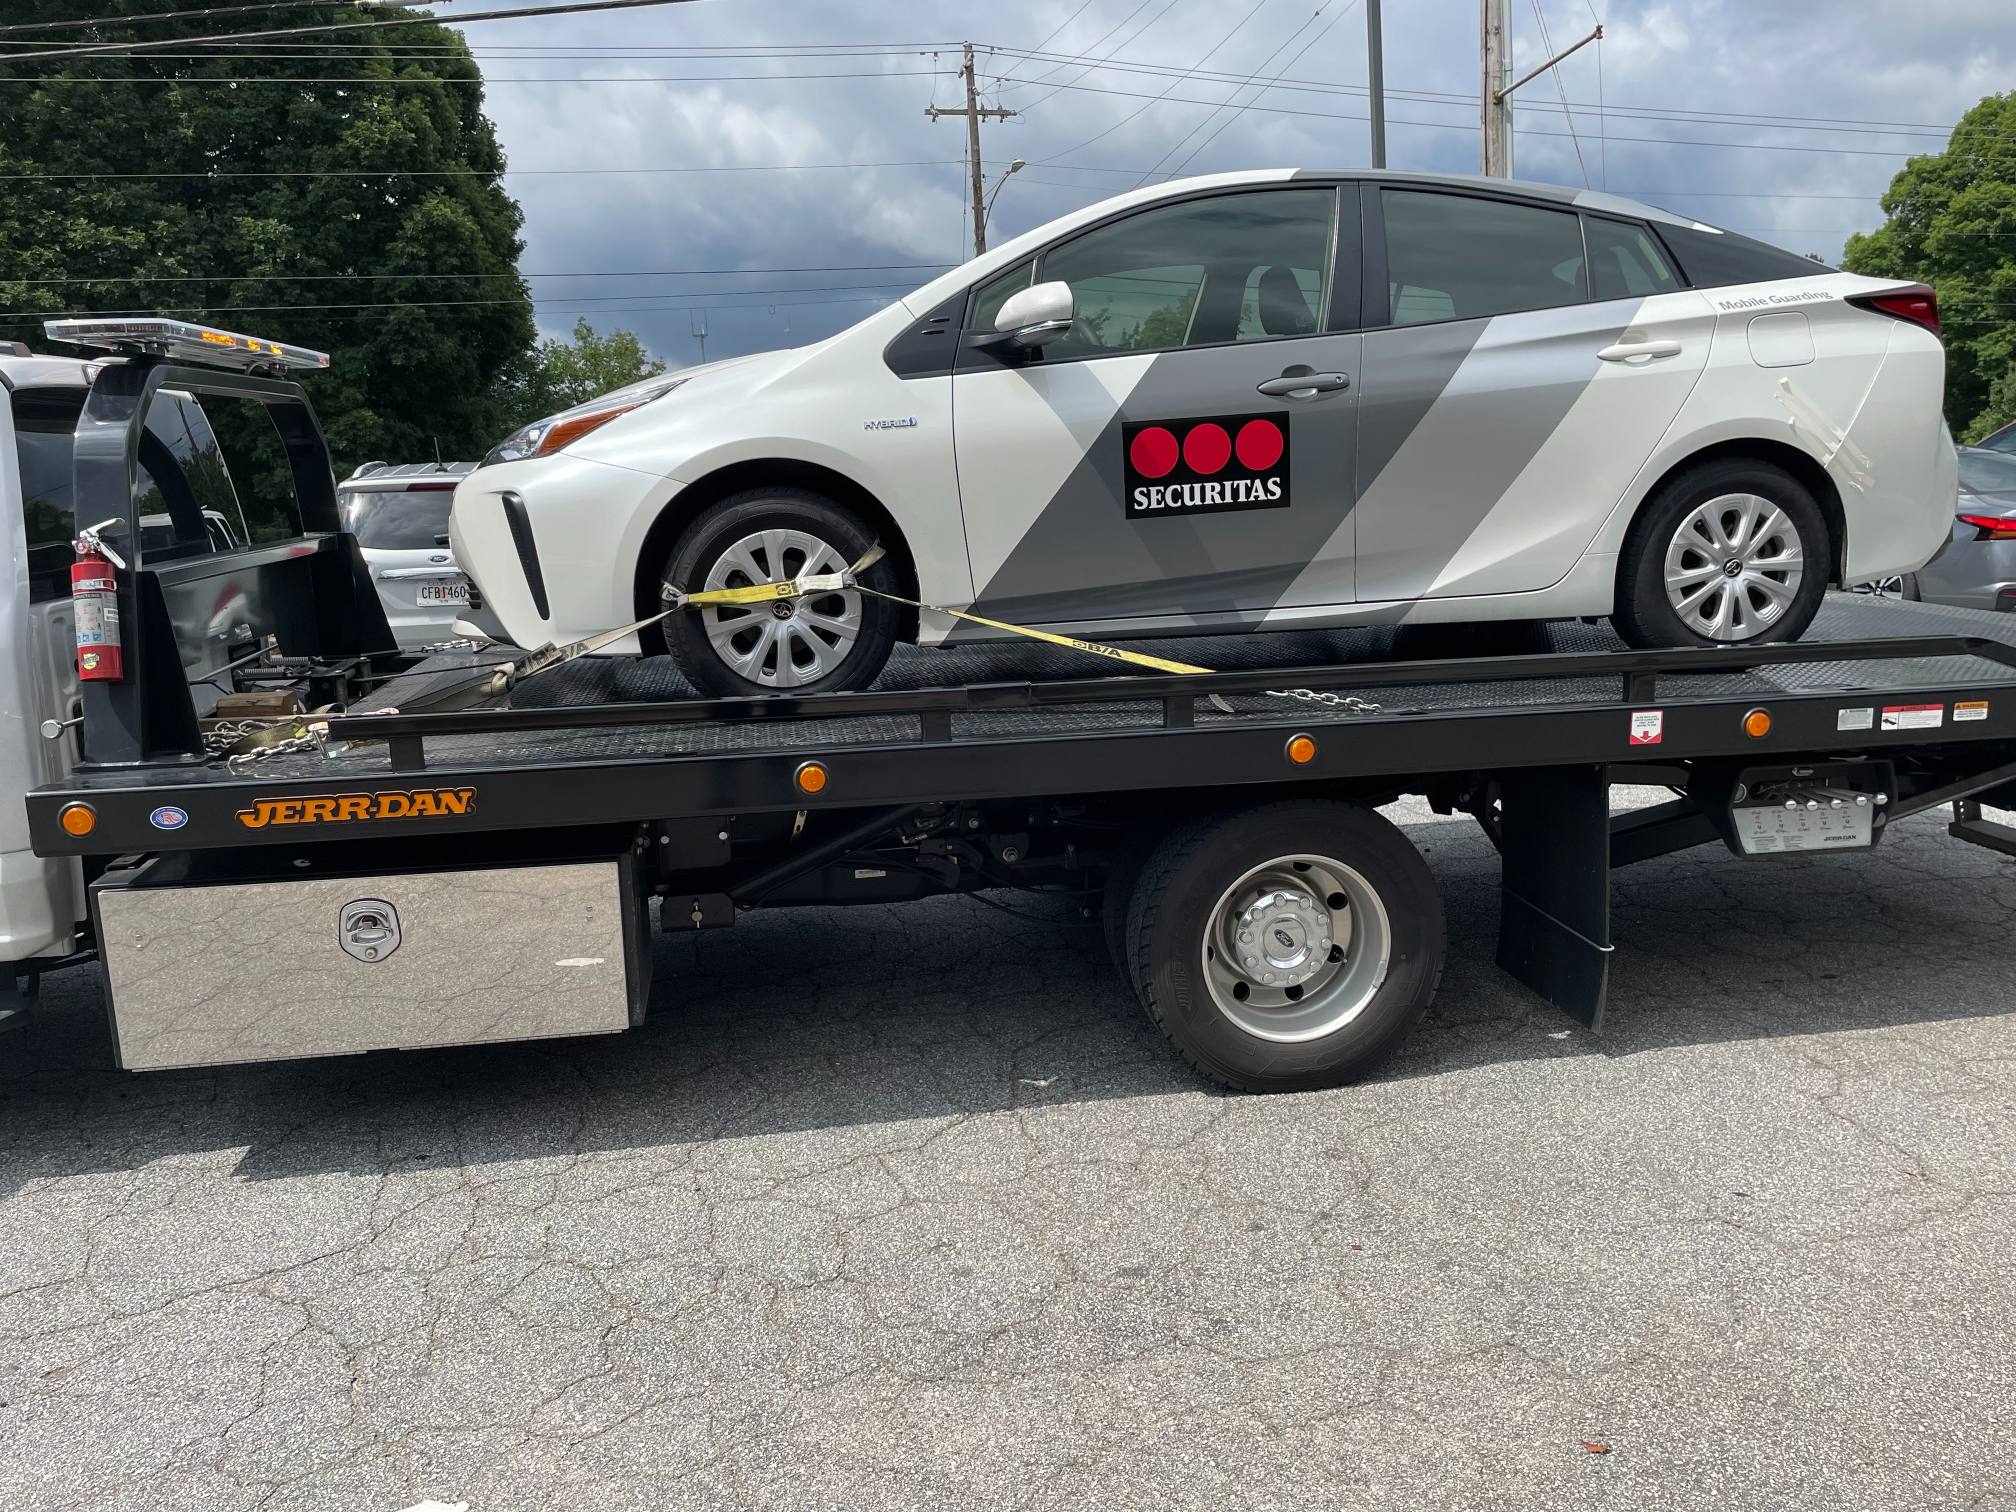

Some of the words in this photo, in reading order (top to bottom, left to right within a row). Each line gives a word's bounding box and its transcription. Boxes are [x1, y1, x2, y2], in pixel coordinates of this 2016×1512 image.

[1718, 297, 1767, 311] Mobile
[1768, 290, 1834, 304] Guarding
[1133, 477, 1282, 510] SECURITAS
[239, 791, 473, 828] JERR-DAN
